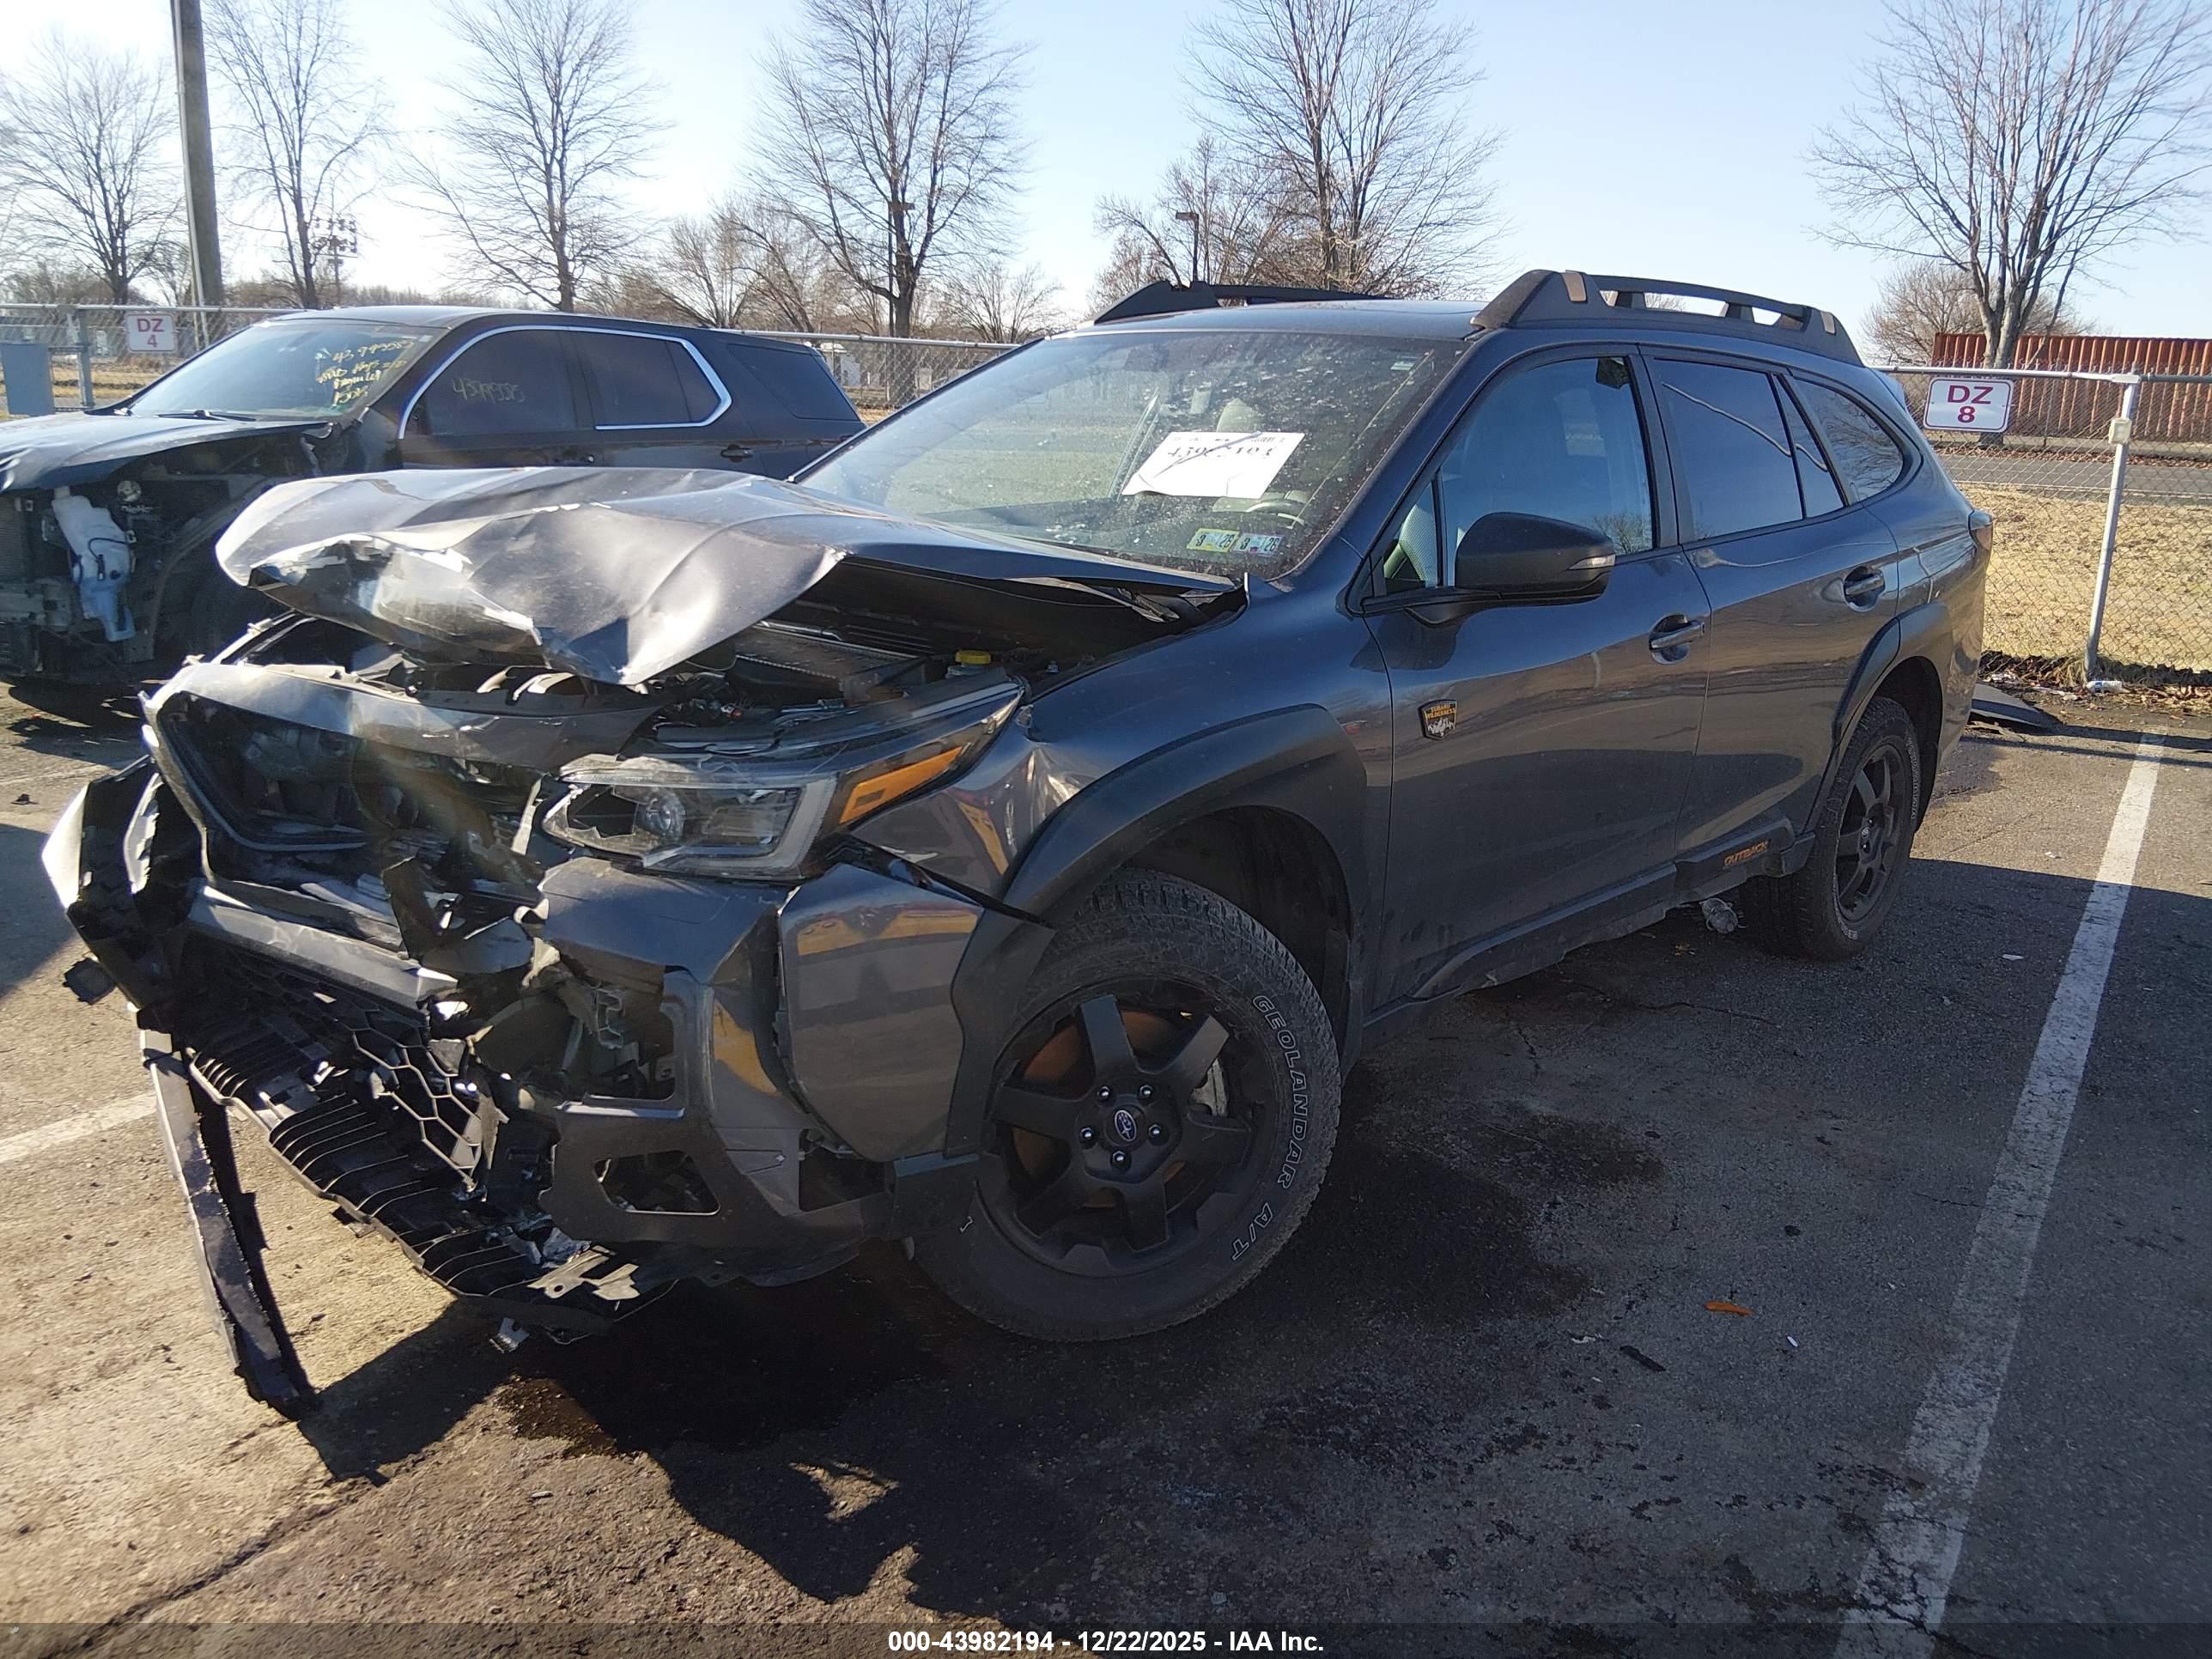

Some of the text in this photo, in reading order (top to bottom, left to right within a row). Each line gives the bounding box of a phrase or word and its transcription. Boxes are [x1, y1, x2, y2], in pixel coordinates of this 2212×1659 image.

[137, 319, 165, 332] DZ
[147, 335, 158, 348] 4
[1948, 386, 1993, 404] DZ
[1958, 406, 1975, 422] 8
[1240, 538, 1251, 550] 3
[1724, 841, 1769, 866] OUTBACK
[1232, 995, 1308, 1261] GEOLANDAR A/T
